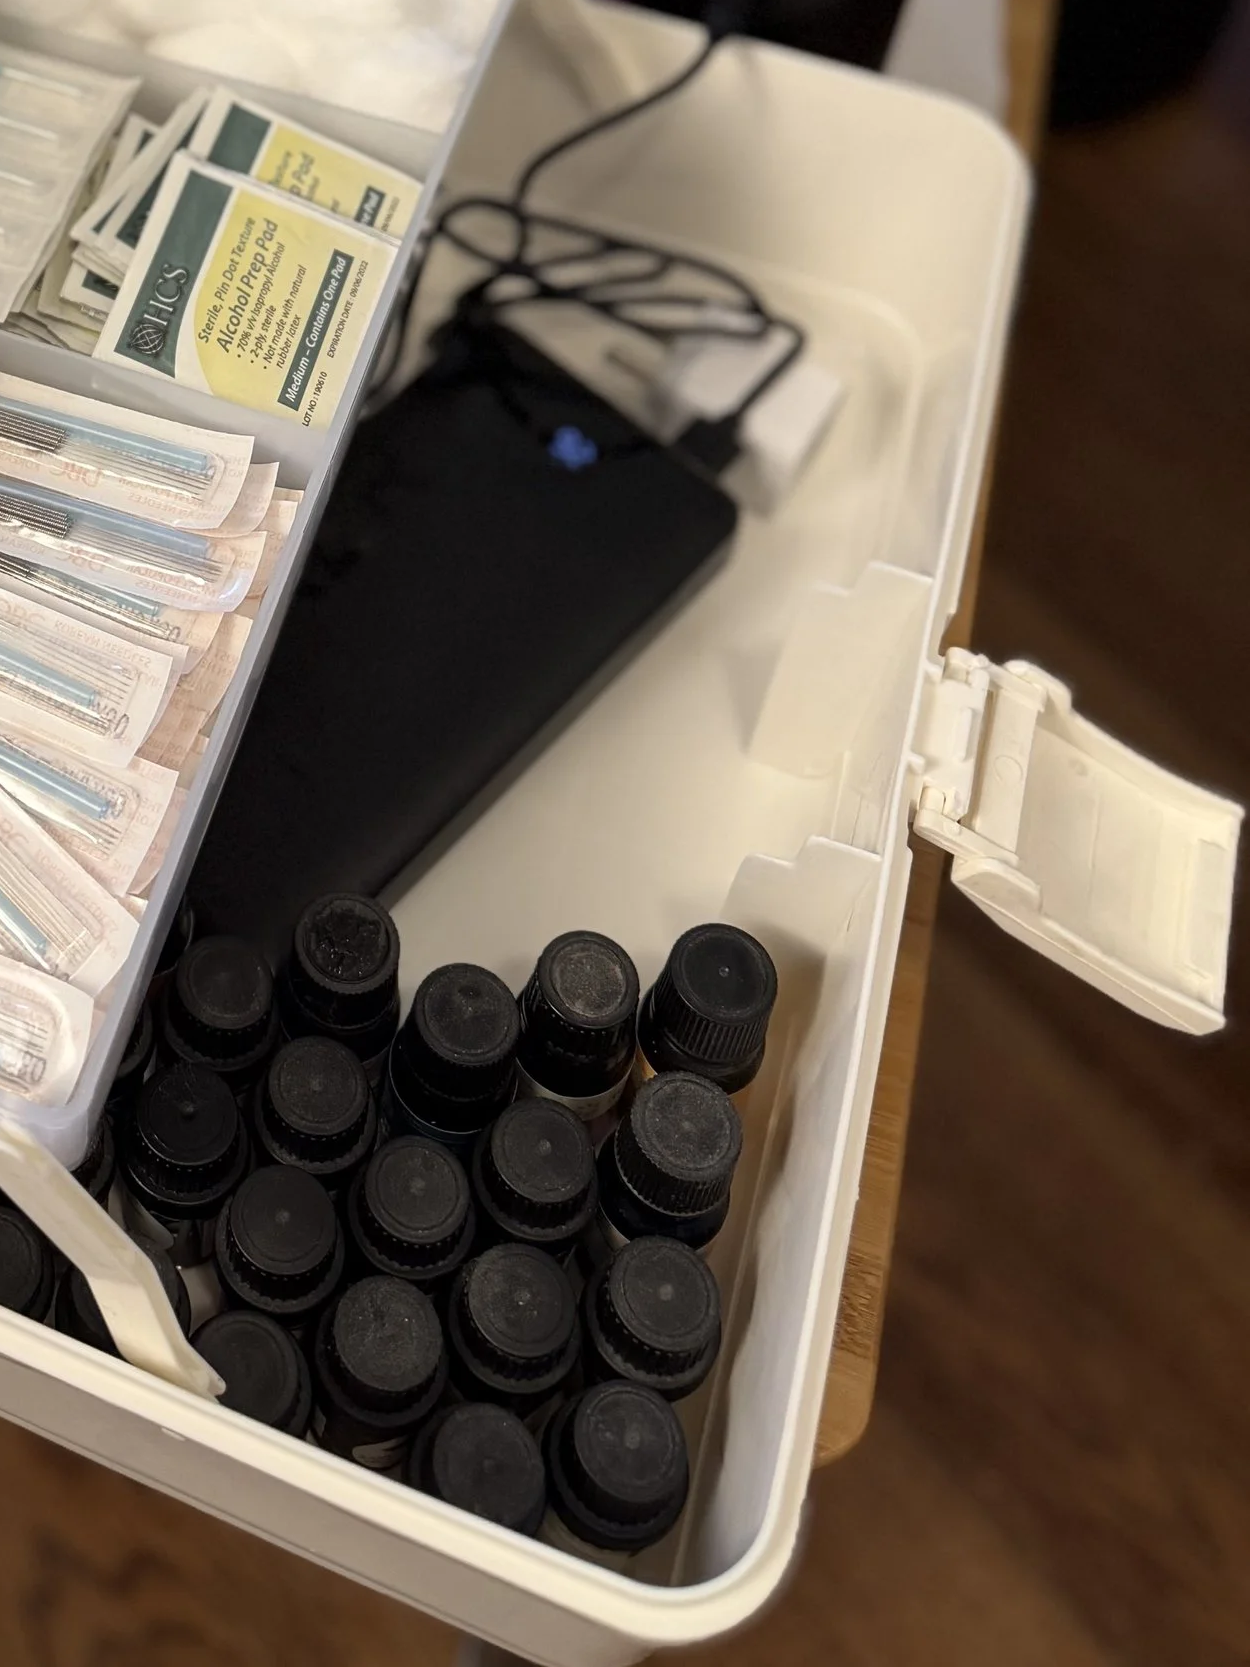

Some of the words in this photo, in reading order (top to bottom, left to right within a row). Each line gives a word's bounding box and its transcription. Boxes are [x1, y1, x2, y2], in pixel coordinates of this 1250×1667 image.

[264, 241, 286, 276] Alcohol
[143, 261, 188, 326] HCS
[196, 300, 223, 343] Sterile,
[214, 280, 229, 301] Pin
[222, 257, 239, 280] Dot
[231, 216, 256, 258] Texture
[213, 286, 251, 352] Alcohol
[239, 250, 269, 289] Prep
[254, 217, 279, 252] Pad
[249, 273, 273, 316] Isopropyl
[287, 264, 307, 298] natural
[244, 313, 258, 330] v/v
[258, 303, 277, 332] sterile
[279, 297, 294, 318] with
[235, 329, 252, 352] 70%
[249, 330, 268, 358] 2-ply,
[268, 317, 286, 345] made
[273, 336, 293, 369] rubber
[285, 313, 302, 338] latex
[284, 355, 310, 402] Medium
[304, 300, 331, 348] Contains
[322, 277, 339, 301] One
[331, 255, 346, 279] Pad
[326, 317, 348, 358] EXPIRATION
[341, 299, 354, 319] DATE
[261, 343, 276, 364] Not
[301, 411, 312, 426] LOT
[312, 370, 328, 396] 190610
